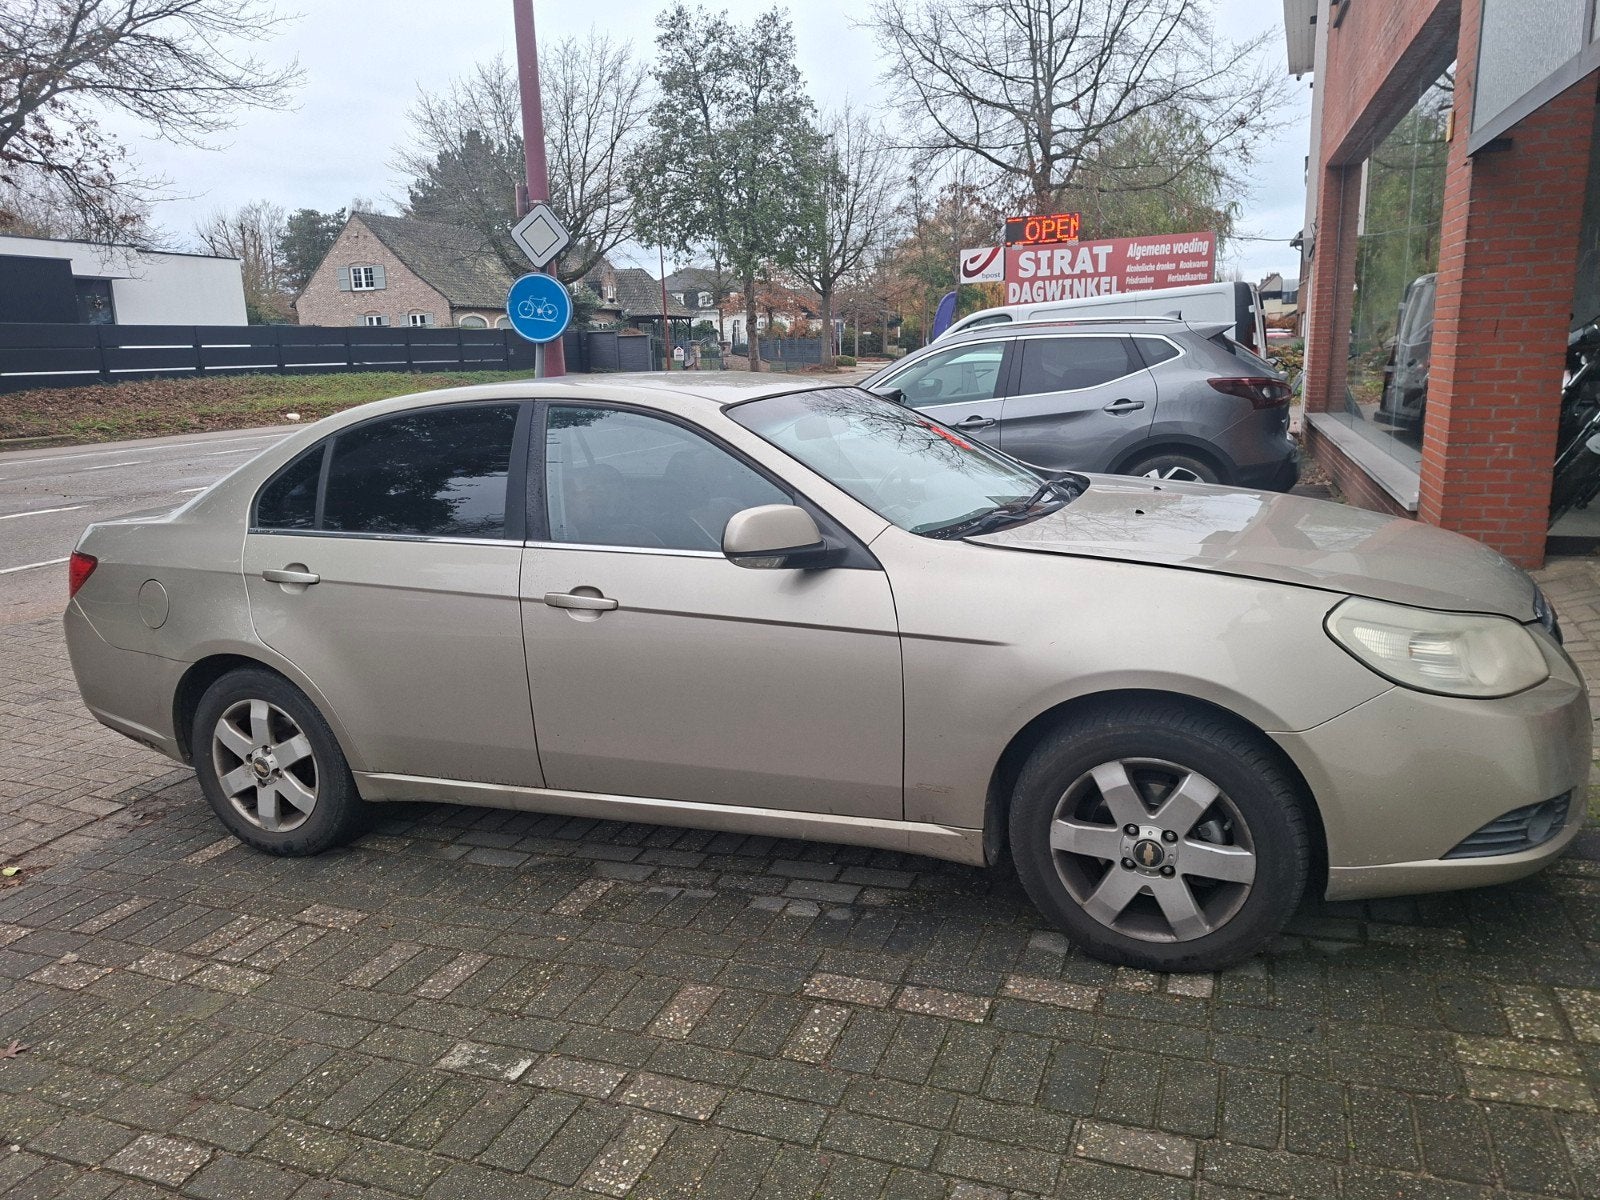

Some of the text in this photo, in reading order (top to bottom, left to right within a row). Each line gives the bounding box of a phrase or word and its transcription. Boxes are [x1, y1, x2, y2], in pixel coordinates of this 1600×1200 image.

[1025, 216, 1079, 241] OPEN
[1126, 238, 1209, 260] Algemene voeding
[1018, 245, 1113, 278] SIRAT
[1126, 261, 1176, 272] Alcoholische dranken
[1179, 260, 1208, 269] Rookwaren
[1008, 275, 1121, 304] DAGWINKEL
[1125, 275, 1154, 285] Frisdranken
